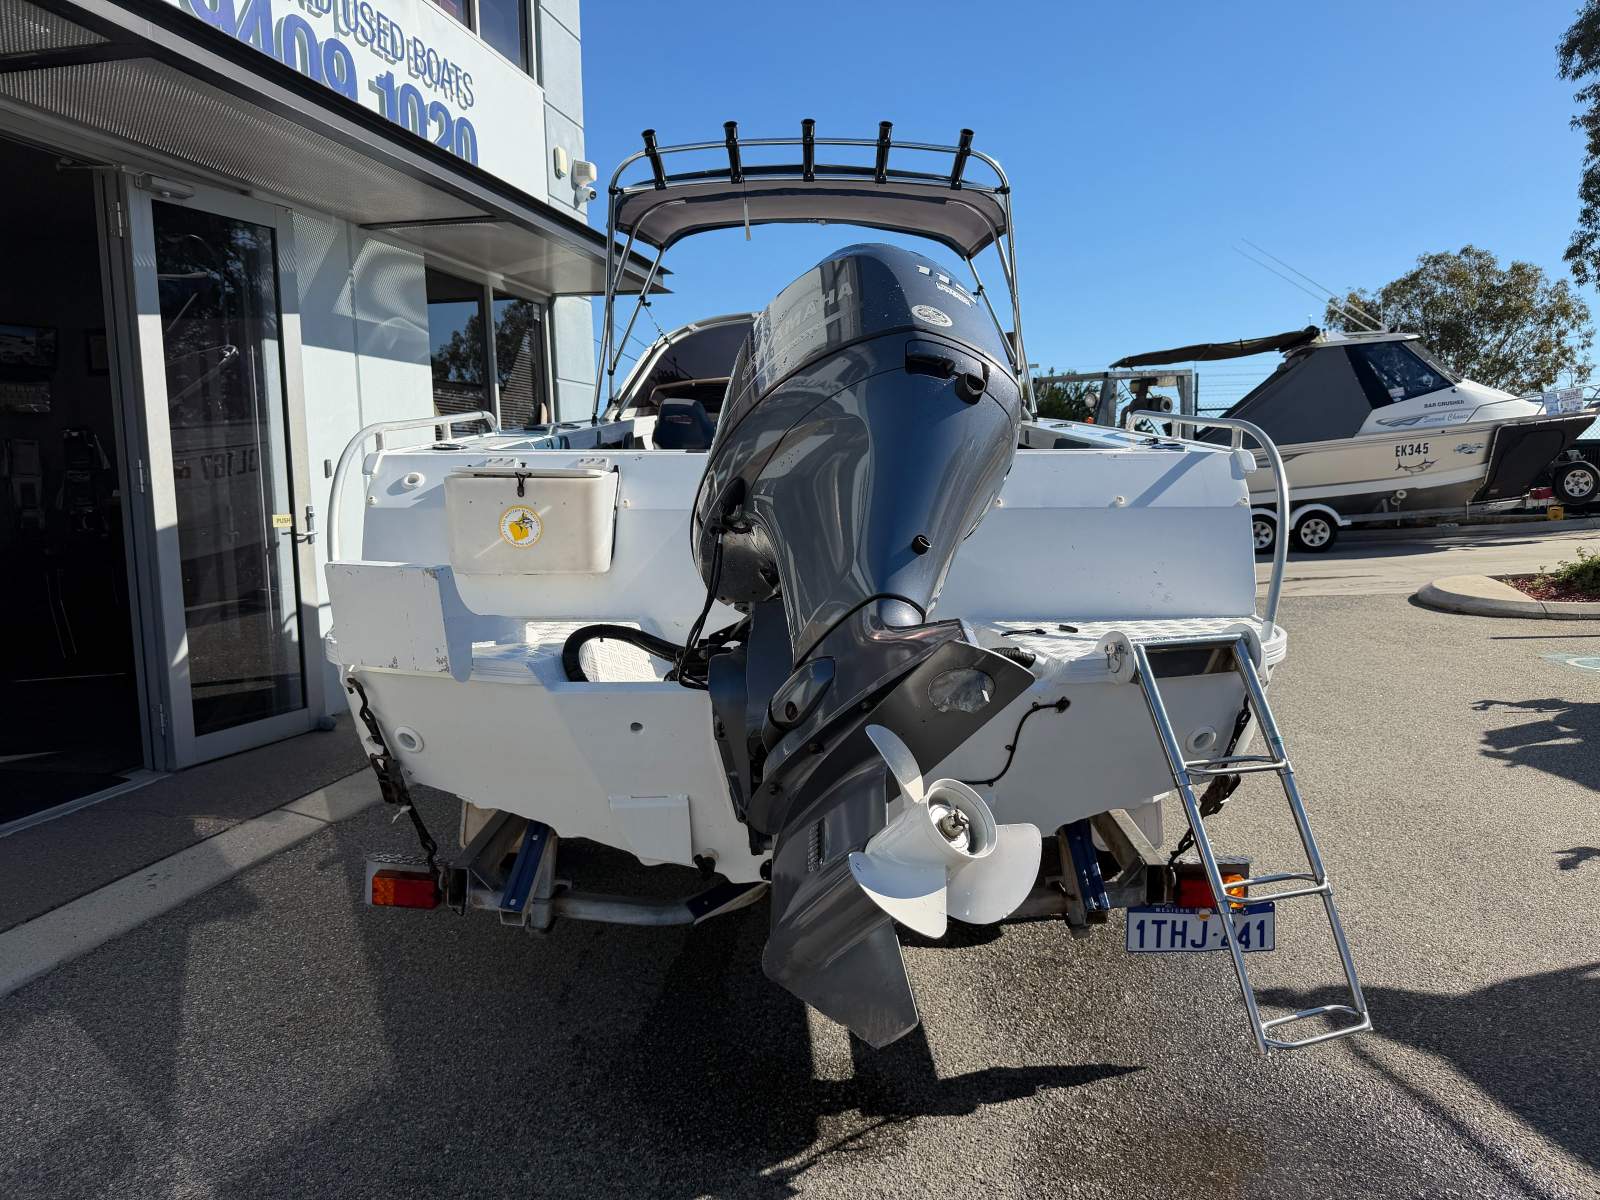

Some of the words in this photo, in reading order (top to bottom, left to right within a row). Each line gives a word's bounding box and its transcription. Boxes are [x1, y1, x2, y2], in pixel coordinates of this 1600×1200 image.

[413, 36, 474, 107] BOATS
[1395, 442, 1429, 457] EK345
[276, 517, 291, 525] PUSH
